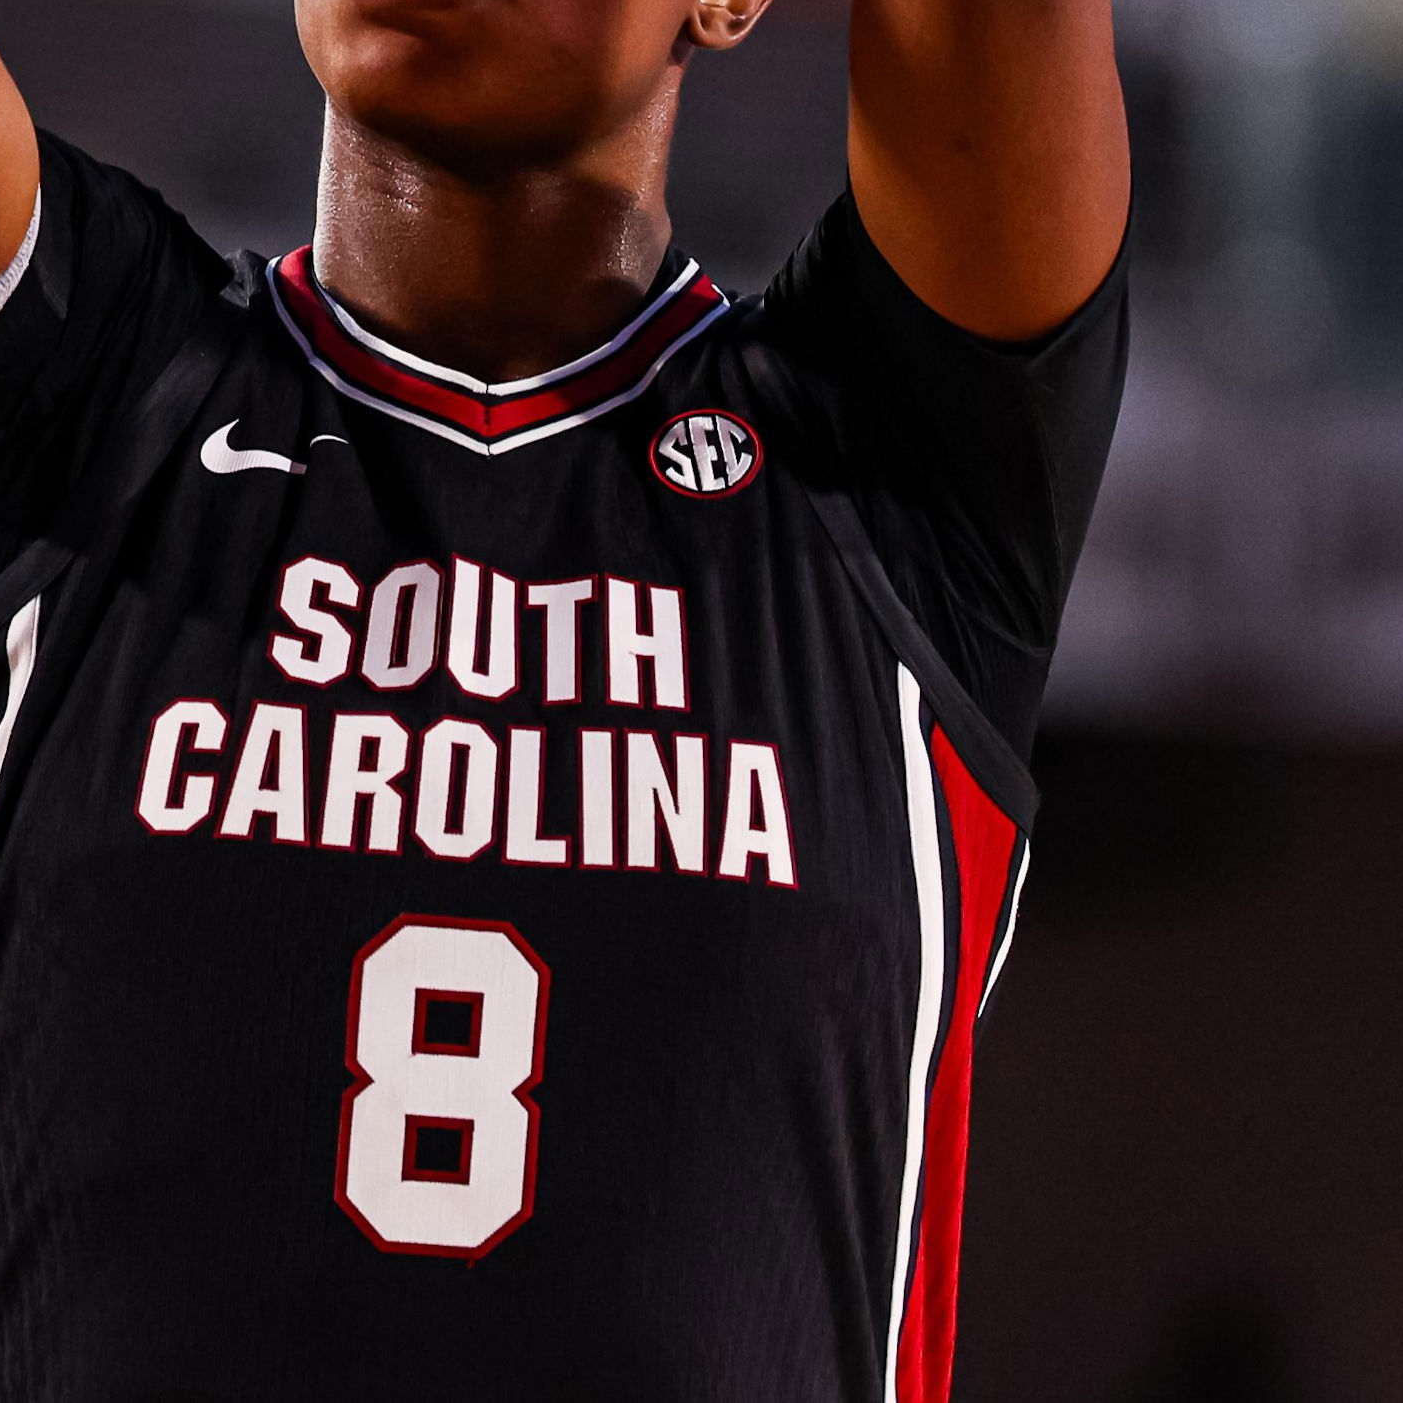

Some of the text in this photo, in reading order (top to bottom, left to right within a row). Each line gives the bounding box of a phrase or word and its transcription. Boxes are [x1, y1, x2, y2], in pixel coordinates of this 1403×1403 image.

[658, 415, 753, 491] SEC
[269, 554, 691, 711] SOUTH
[136, 699, 798, 889] CAROLINA
[335, 914, 551, 1258] 8
